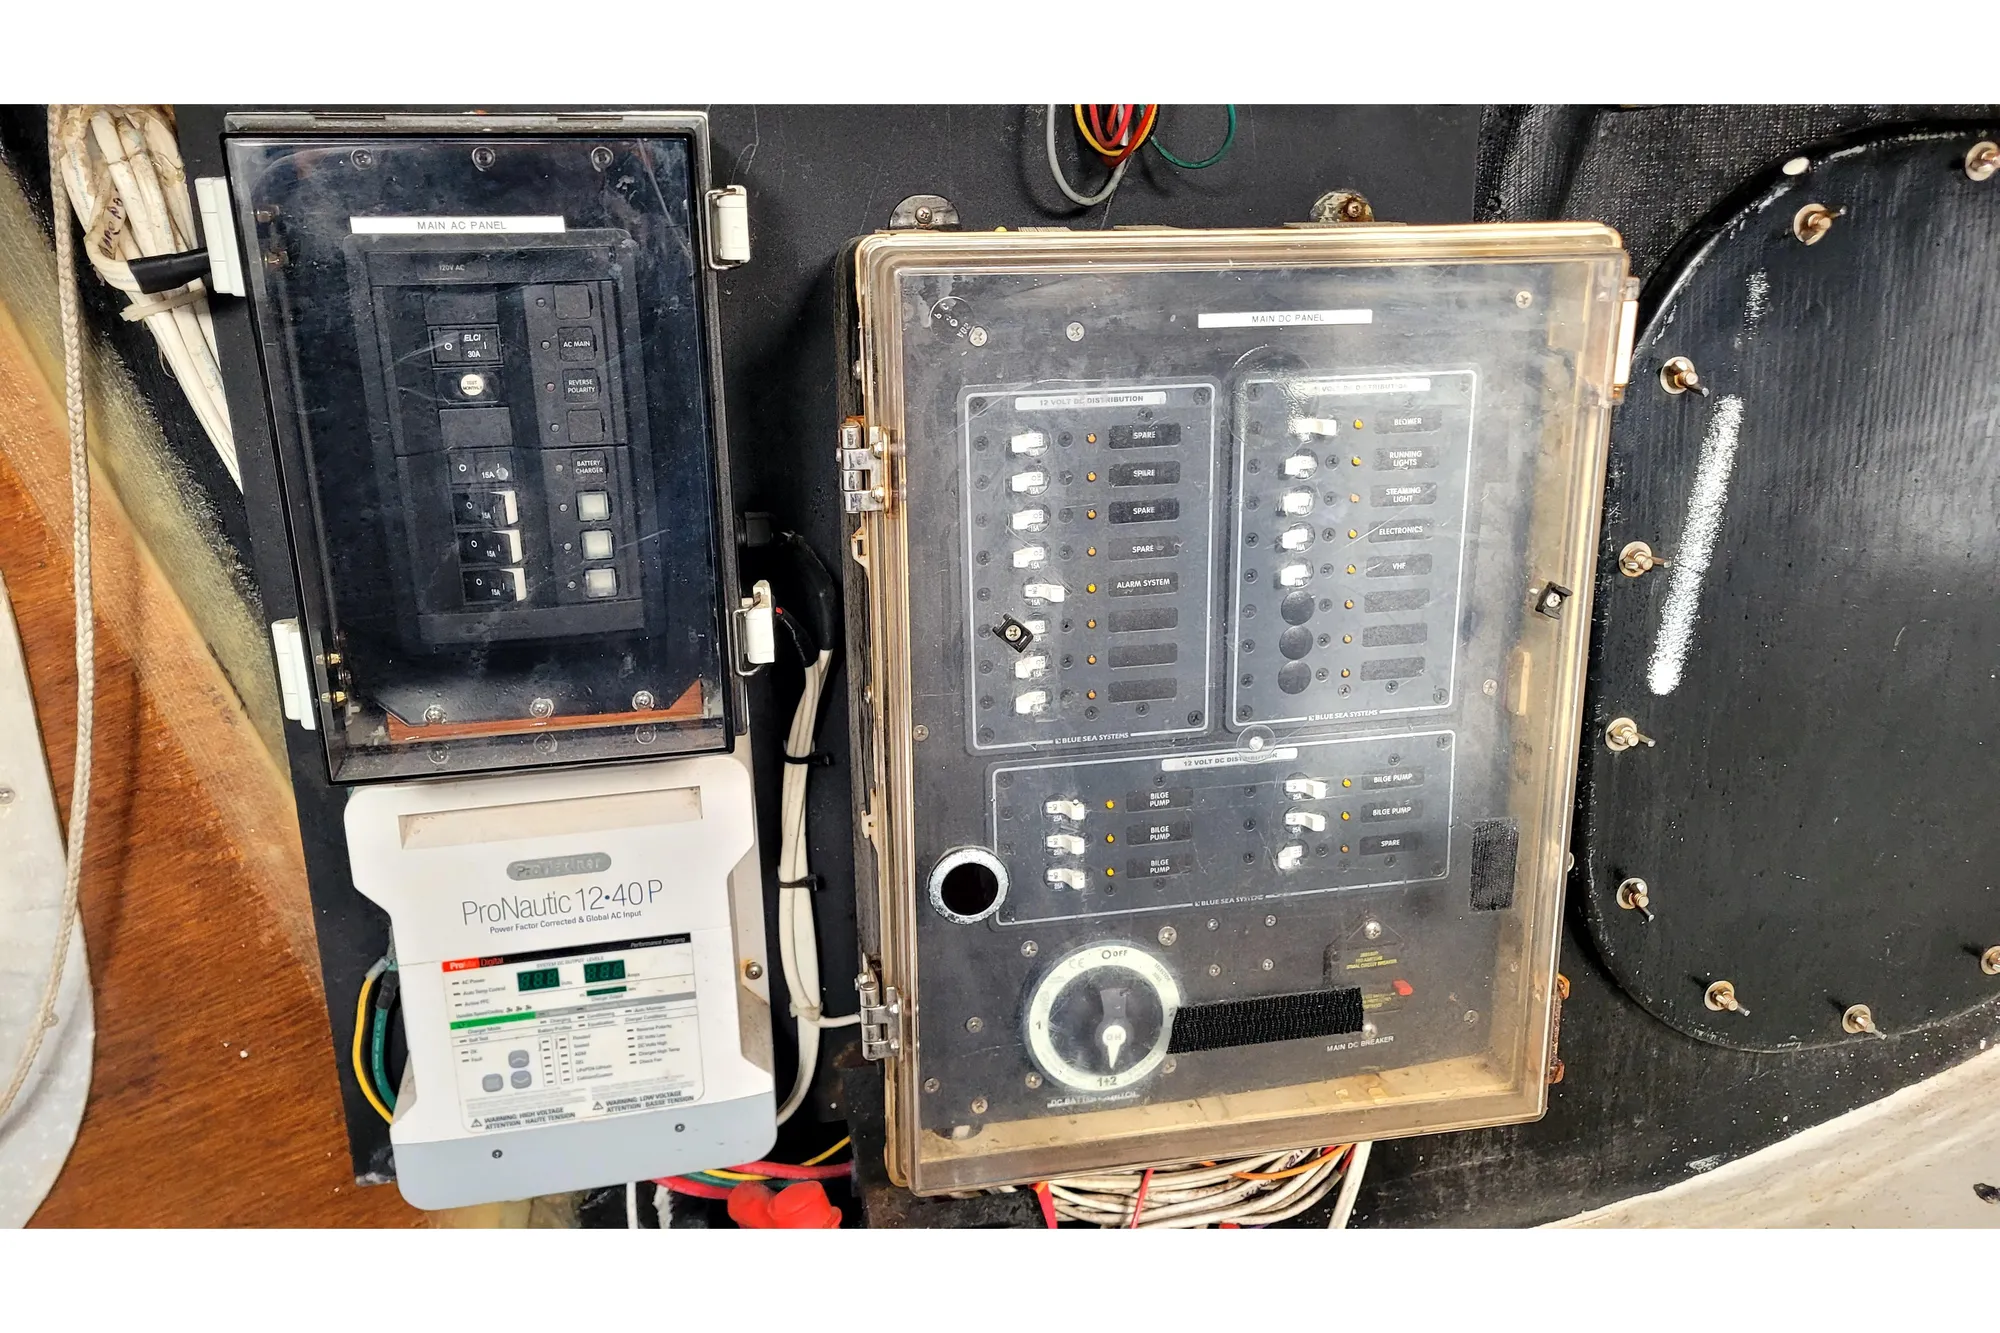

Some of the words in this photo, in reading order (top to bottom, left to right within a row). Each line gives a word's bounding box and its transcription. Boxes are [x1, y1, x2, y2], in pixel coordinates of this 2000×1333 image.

[417, 221, 446, 231] MAIN
[450, 221, 467, 231] AC
[470, 220, 508, 231] PANEL
[438, 264, 455, 272] 120V
[455, 263, 465, 271] AC
[1251, 314, 1275, 323] MAIN
[1278, 314, 1291, 322] DC
[1294, 313, 1324, 322] PANEL
[574, 340, 591, 348] MAIN
[467, 350, 481, 358] 30A
[568, 379, 593, 387] REVERSE
[568, 386, 596, 394] POLARITY
[1049, 398, 1071, 406] VOLT
[1086, 395, 1144, 405] DISTRIBUTION
[1394, 417, 1422, 426] BLOWER
[1132, 431, 1156, 440] SPARE
[1389, 450, 1422, 459] RUNNING
[1393, 458, 1417, 467] LIGHTS
[481, 471, 495, 479] 15A
[575, 466, 604, 475] CHARGER
[1133, 468, 1156, 478] SPARE
[1386, 486, 1421, 496] STEAMING
[1393, 494, 1413, 503] LIGHT
[1132, 506, 1156, 515] SPARE
[481, 511, 491, 520] 15A
[1379, 525, 1423, 536] ELECTRONICS
[486, 550, 496, 558] 15A
[1131, 545, 1155, 554] SPARE
[1030, 562, 1041, 570] 15A
[1392, 562, 1406, 570] VHF
[1116, 580, 1142, 589] ALARM
[1143, 578, 1171, 587] SYSTEM
[491, 588, 501, 596] 15A
[1315, 713, 1334, 721] BLUE
[1350, 709, 1378, 718] SYSTEMS
[1062, 736, 1081, 744] BLUE
[1099, 732, 1129, 741] SYSTEMS
[1194, 758, 1213, 766] VOLT
[1373, 775, 1392, 783] BILGE
[1393, 773, 1413, 781] PUMP
[1150, 791, 1169, 799] BILGE
[1149, 799, 1170, 807] PUMP
[1372, 809, 1391, 817] BILGE
[1392, 807, 1412, 815] PUMP
[1150, 826, 1169, 834] BILGE
[1150, 833, 1171, 841] PUMP
[1381, 839, 1400, 847] SPARE
[1150, 859, 1169, 867] BILGE
[1150, 866, 1170, 874] PUMP
[1201, 899, 1220, 907] BLUE
[462, 891, 571, 926] ProNautic
[490, 925, 514, 934] Power
[515, 922, 538, 931] Factor
[540, 917, 577, 929] Corrected
[586, 913, 609, 922] Global
[623, 910, 642, 919] Input
[630, 939, 662, 948] Performance
[663, 937, 686, 945] Charging
[481, 957, 504, 968] Digital
[1036, 1020, 1041, 1030] 1
[1327, 1043, 1346, 1052] MAIN
[1347, 1041, 1359, 1049] DC
[1360, 1035, 1394, 1047] BREAKER
[1096, 1076, 1117, 1087] 1+2
[639, 1094, 656, 1102] LOW
[656, 1090, 682, 1100] VOLTAGE
[667, 1096, 694, 1105] TENSION
[519, 1110, 536, 1119] HIGH
[536, 1107, 564, 1116] VOLTAGE
[525, 1117, 546, 1125] HAUTE
[547, 1112, 575, 1122] TENSION
